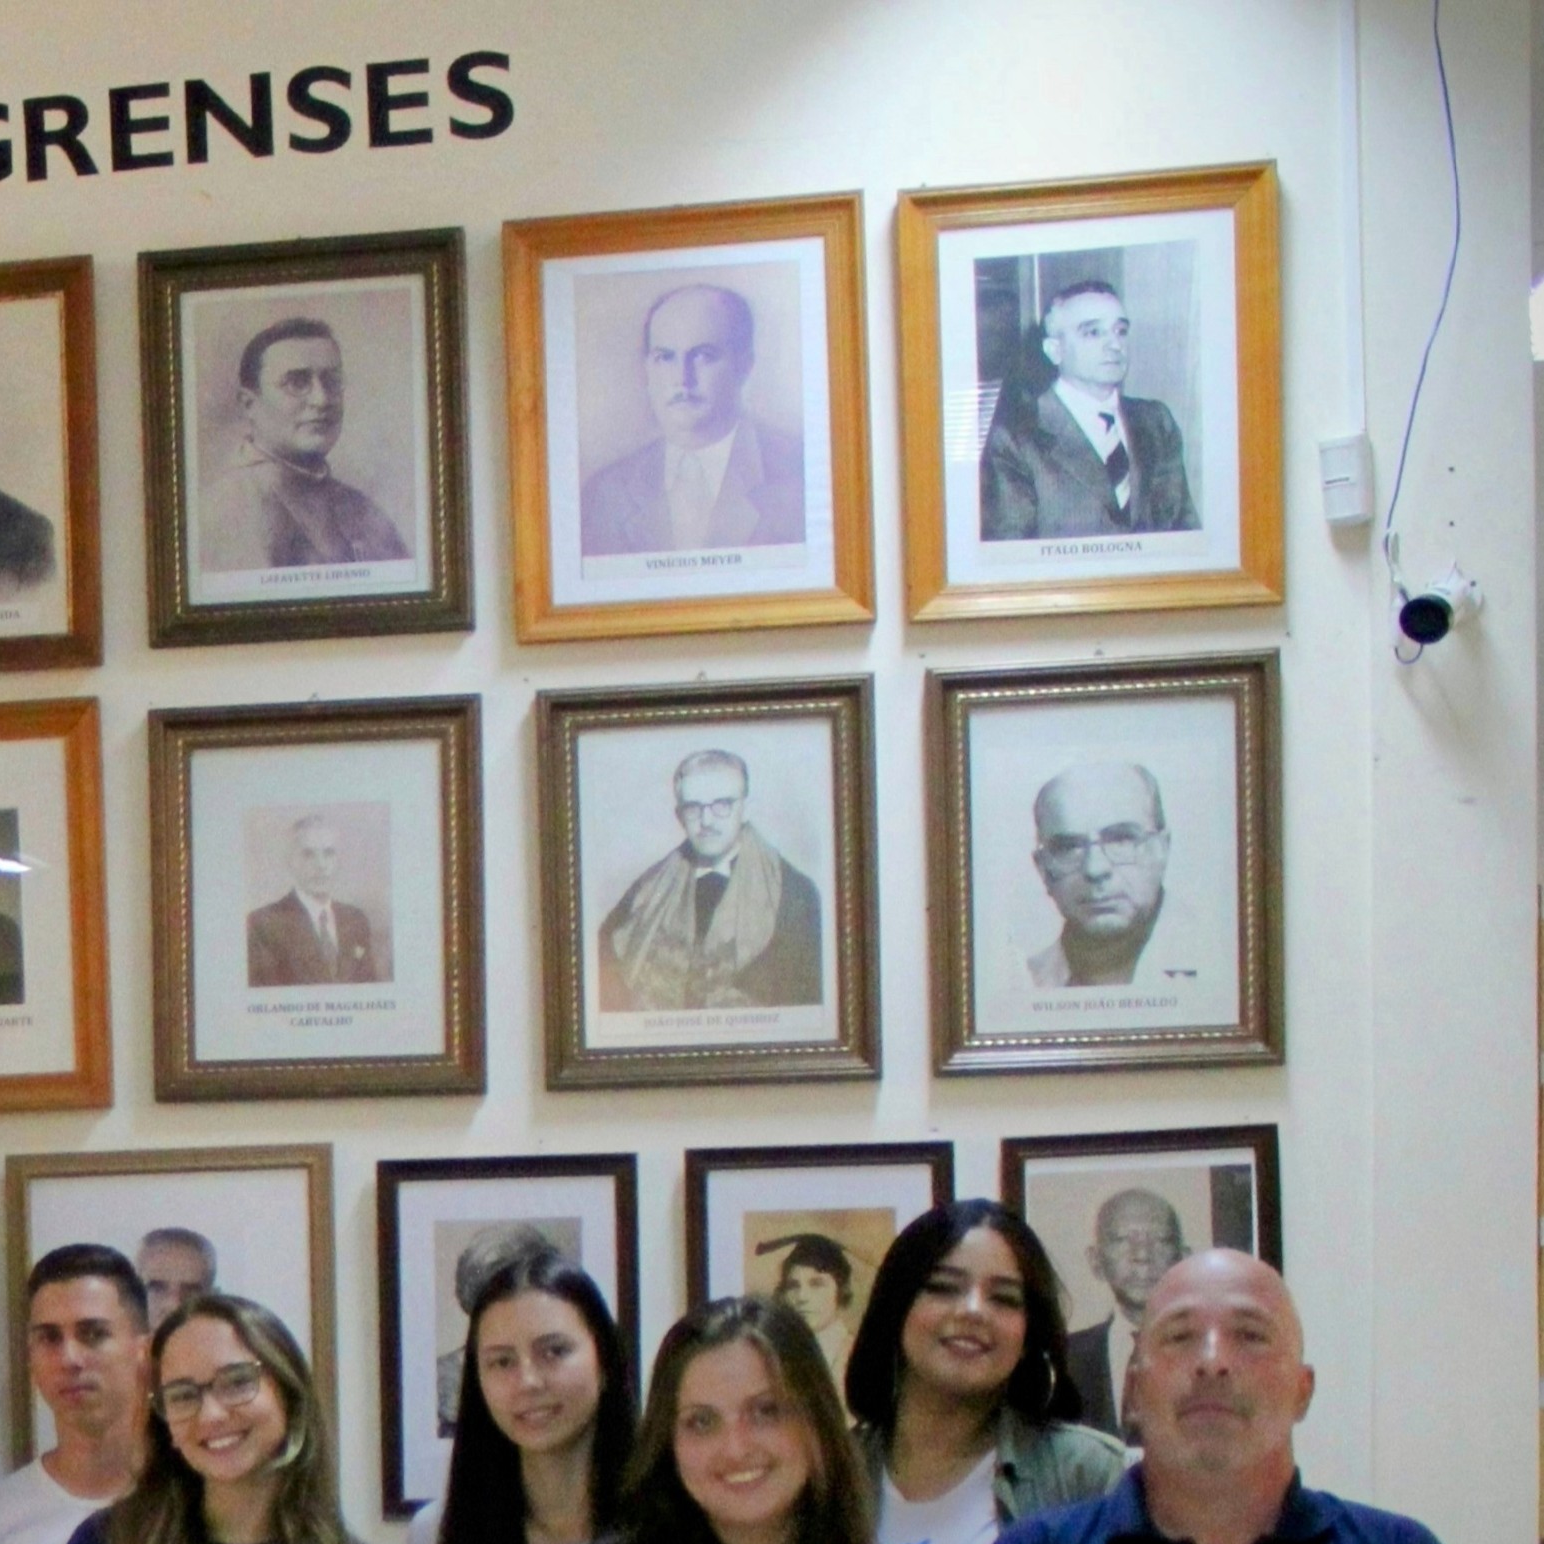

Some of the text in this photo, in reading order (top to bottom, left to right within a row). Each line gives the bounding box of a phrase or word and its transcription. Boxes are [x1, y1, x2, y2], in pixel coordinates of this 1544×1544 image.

[1082, 541, 1143, 553] BOLOGNA
[701, 554, 743, 566] MEYER
[247, 1002, 304, 1013] ORLANDO
[306, 1002, 320, 1012] DE
[1032, 1001, 1081, 1012] WILSON
[290, 1016, 354, 1026] CARVALHO
[707, 1015, 721, 1026] DE
[725, 1013, 780, 1026] QUEIROZ
